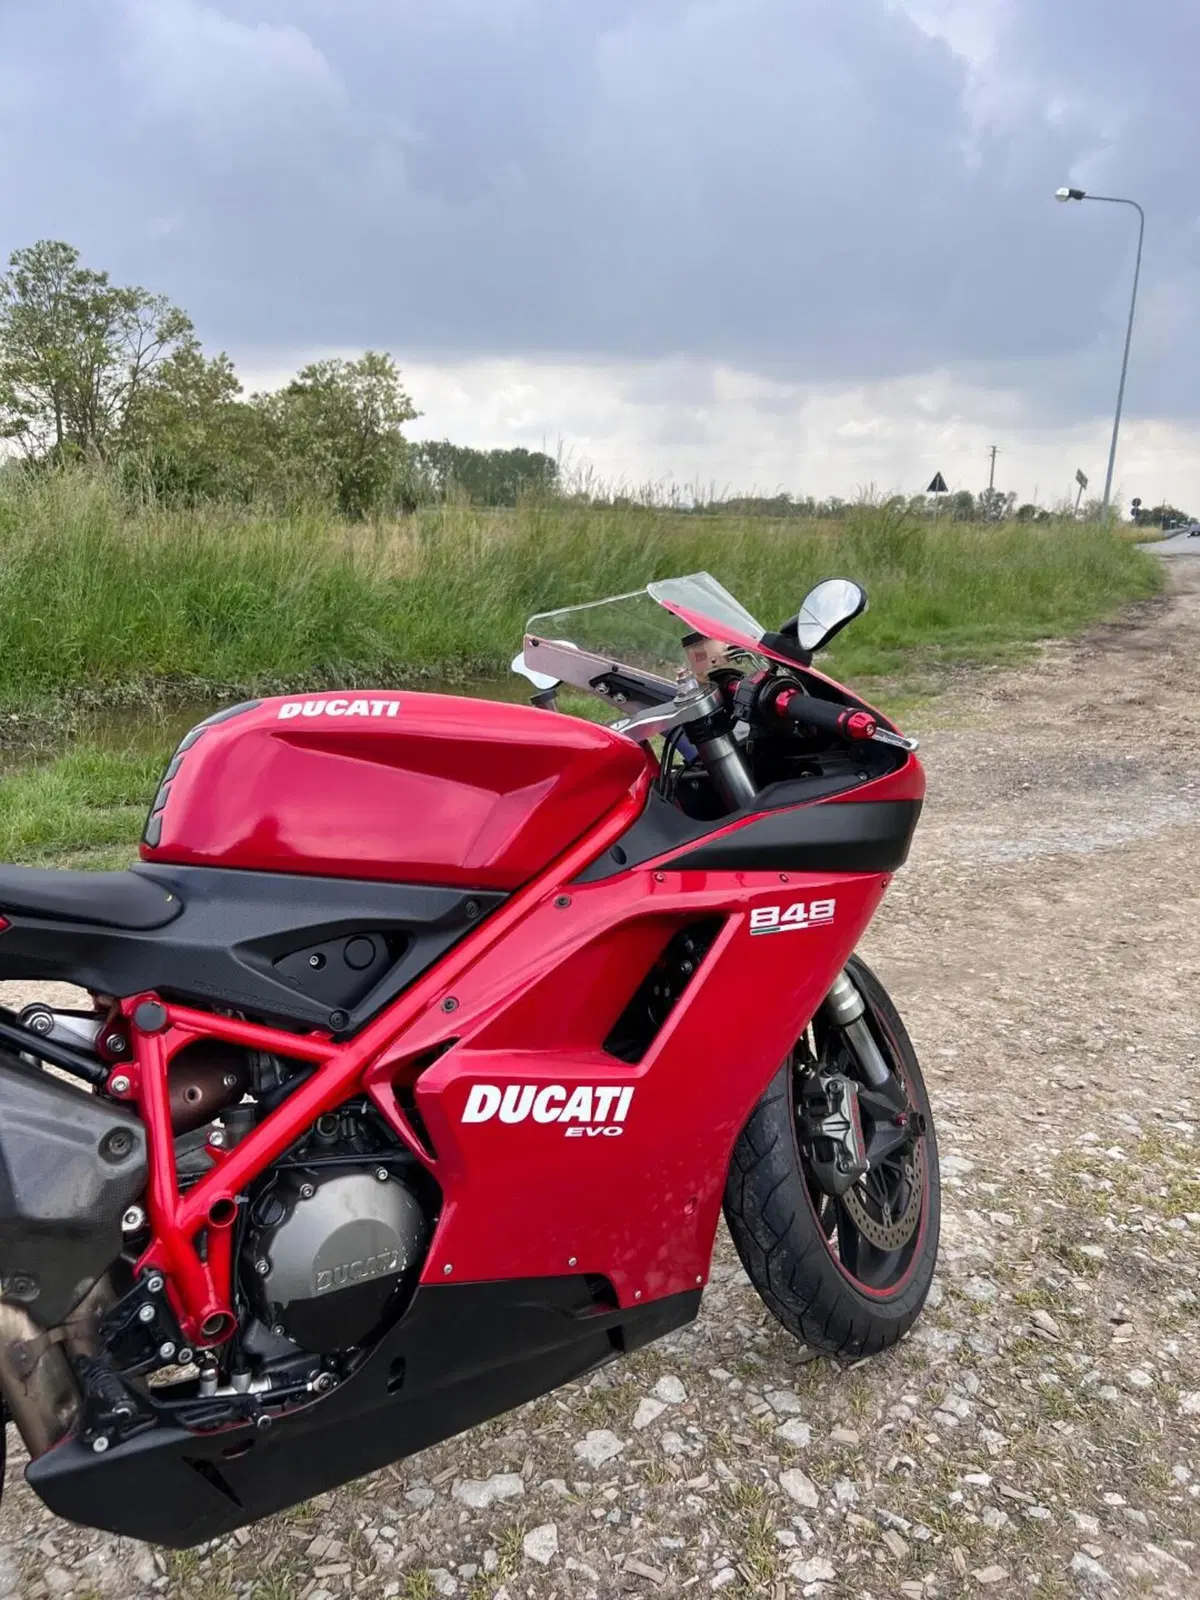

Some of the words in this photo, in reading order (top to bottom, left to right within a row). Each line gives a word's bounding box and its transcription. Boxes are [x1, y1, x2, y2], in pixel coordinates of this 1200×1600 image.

[278, 699, 400, 719] DUCATI
[750, 899, 836, 928] 848
[461, 1084, 635, 1123] DUCATI
[564, 1126, 624, 1137] EVO
